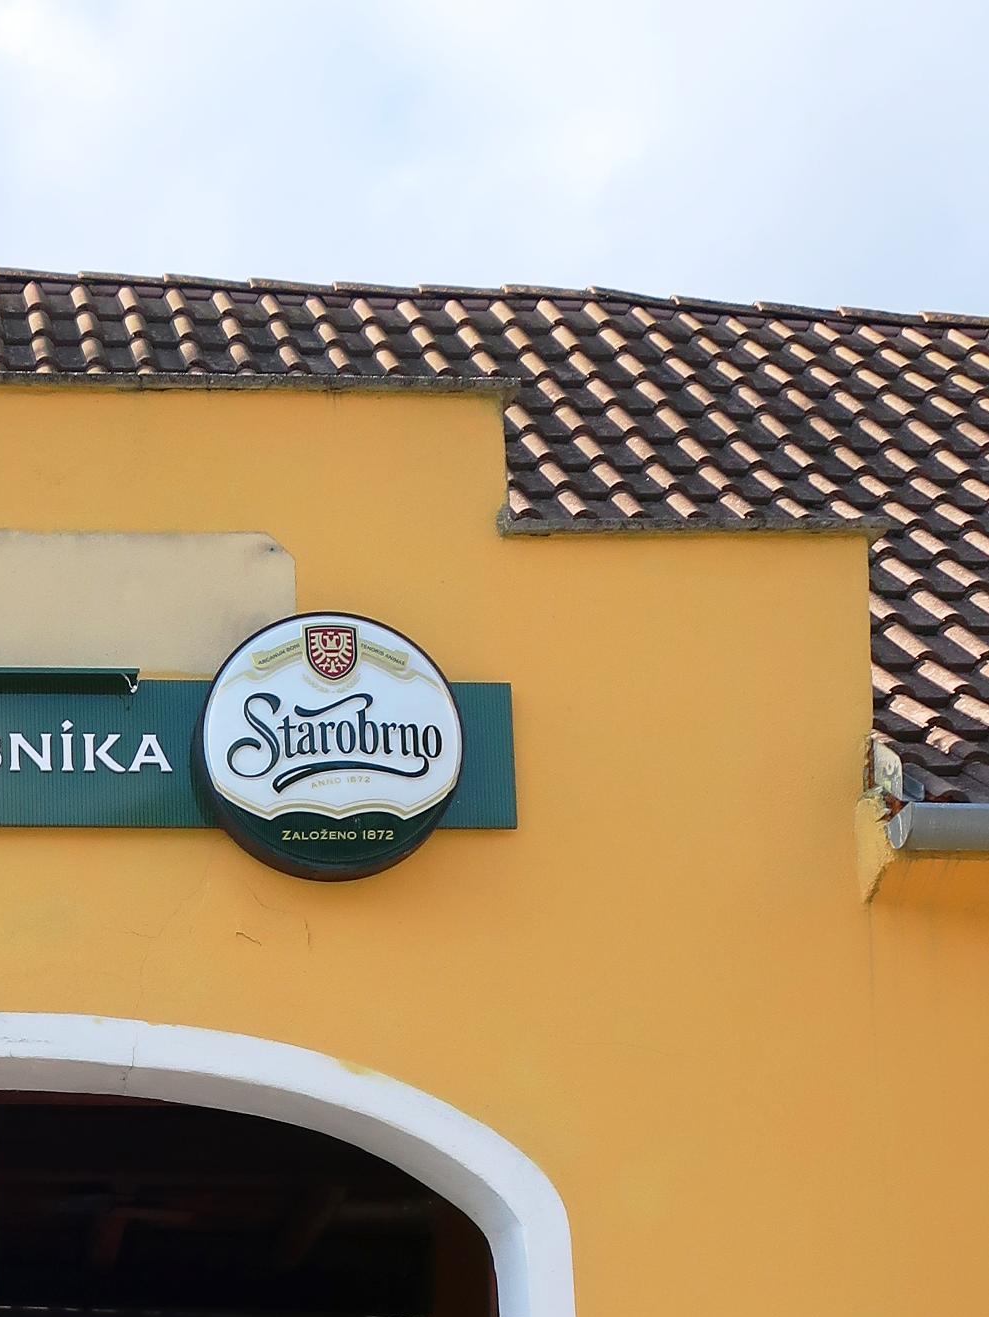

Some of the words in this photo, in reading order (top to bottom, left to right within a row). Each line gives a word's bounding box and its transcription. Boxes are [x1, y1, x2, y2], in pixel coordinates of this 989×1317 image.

[226, 692, 442, 794] Starobrno
[281, 828, 358, 841] ZALOŽENO
[362, 829, 395, 841] 1872
